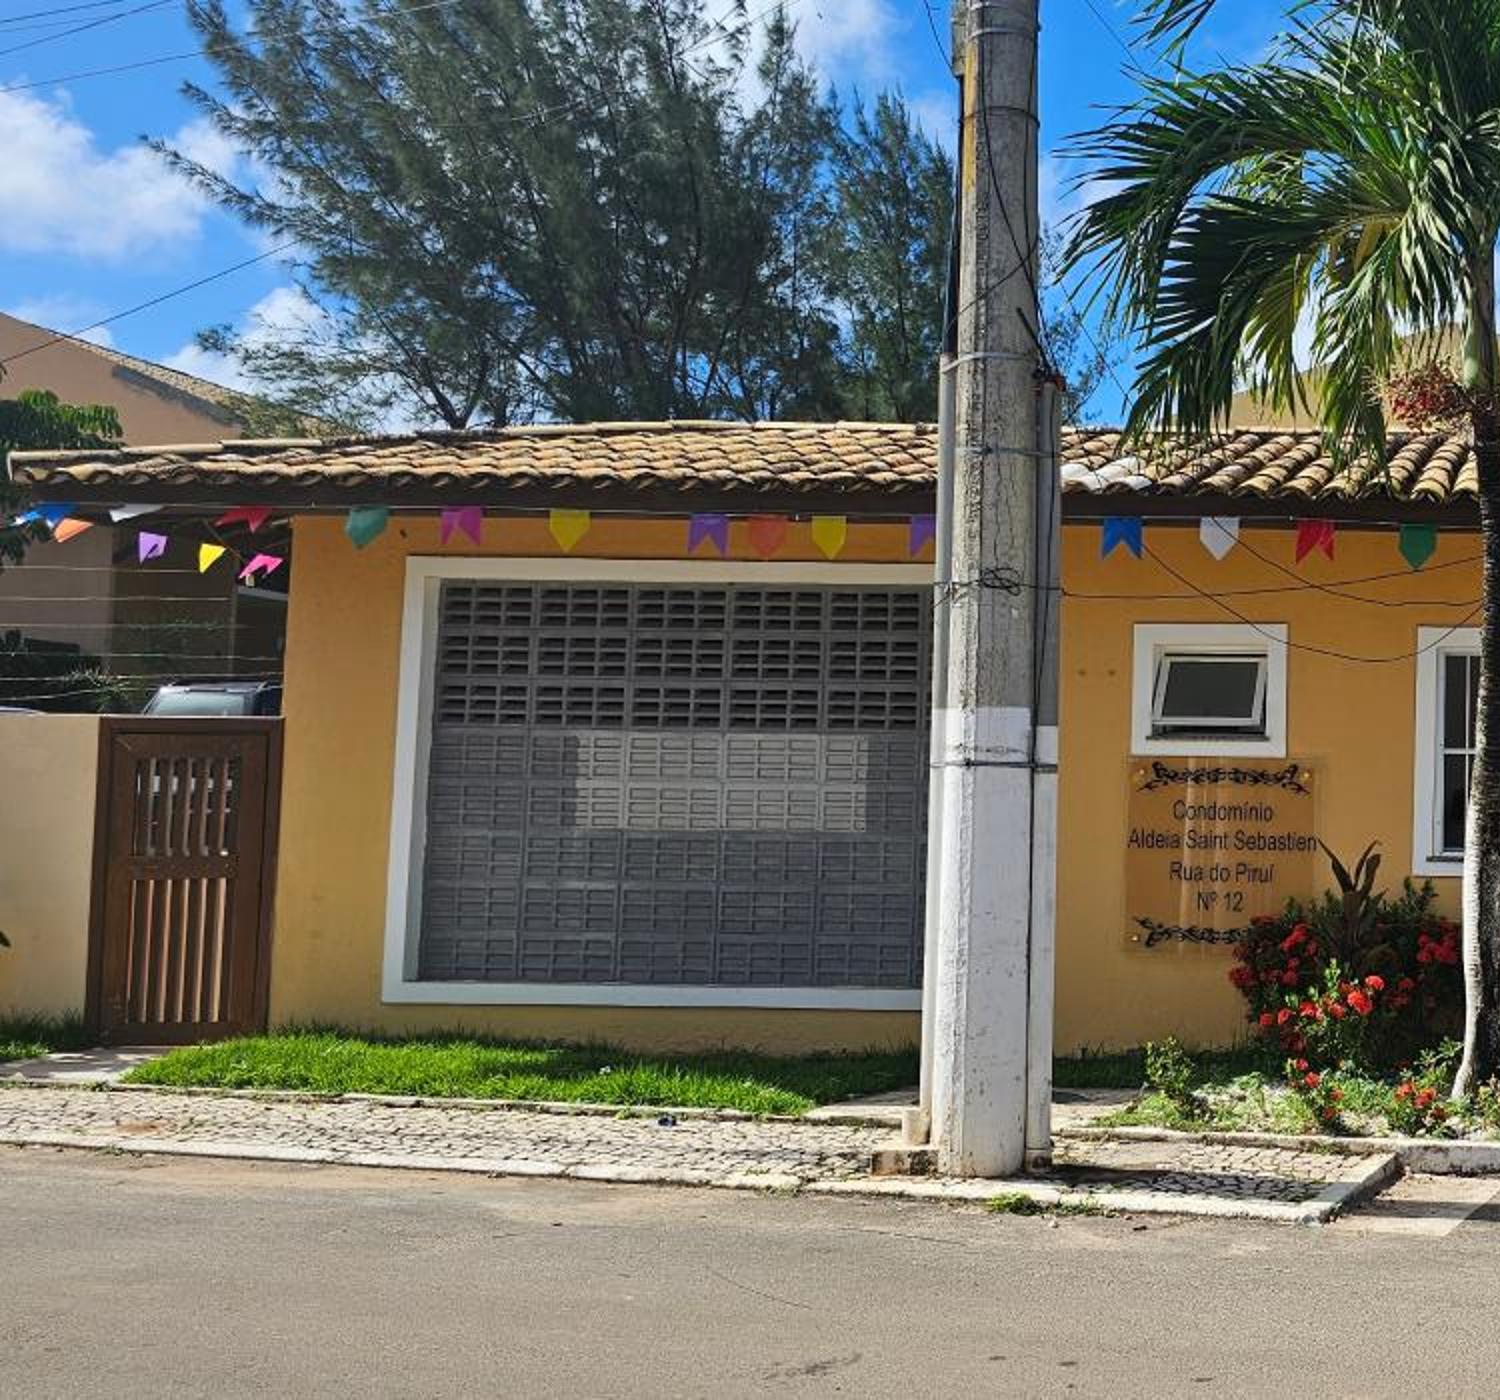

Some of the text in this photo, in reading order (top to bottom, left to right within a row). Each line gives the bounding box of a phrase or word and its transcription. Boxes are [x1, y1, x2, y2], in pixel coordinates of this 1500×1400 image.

[1173, 800, 1273, 822] Condomínio
[1127, 828, 1317, 852] Aldeia Saint Sebastien
[1169, 861, 1203, 881] Rua
[1209, 861, 1231, 882] do
[1223, 892, 1244, 912] 12
